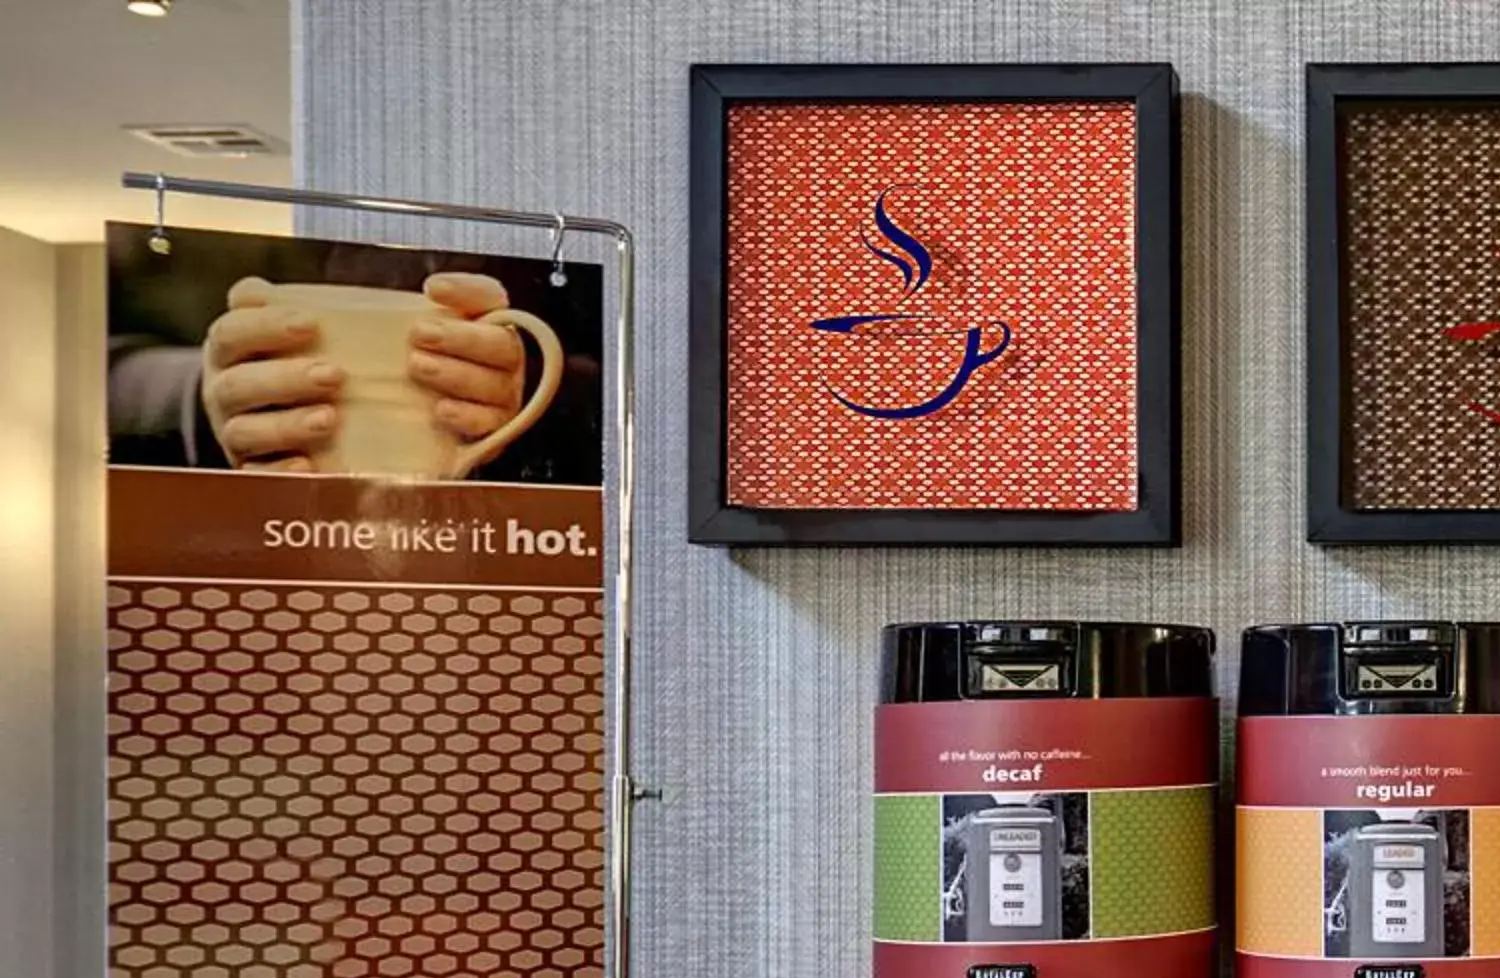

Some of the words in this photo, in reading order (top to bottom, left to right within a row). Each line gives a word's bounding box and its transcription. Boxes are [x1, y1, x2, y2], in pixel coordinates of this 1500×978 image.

[263, 519, 375, 550] some
[471, 518, 496, 553] it
[506, 518, 598, 556] hot.
[951, 750, 966, 762] the
[968, 749, 996, 762] flavor
[998, 749, 1021, 761] with
[1023, 750, 1039, 760] no
[982, 763, 1045, 783] decaf
[1330, 765, 1367, 777] smooth
[1369, 765, 1400, 777] blend
[1402, 765, 1423, 778] just
[1425, 764, 1440, 776] for
[1356, 780, 1436, 802] regular
